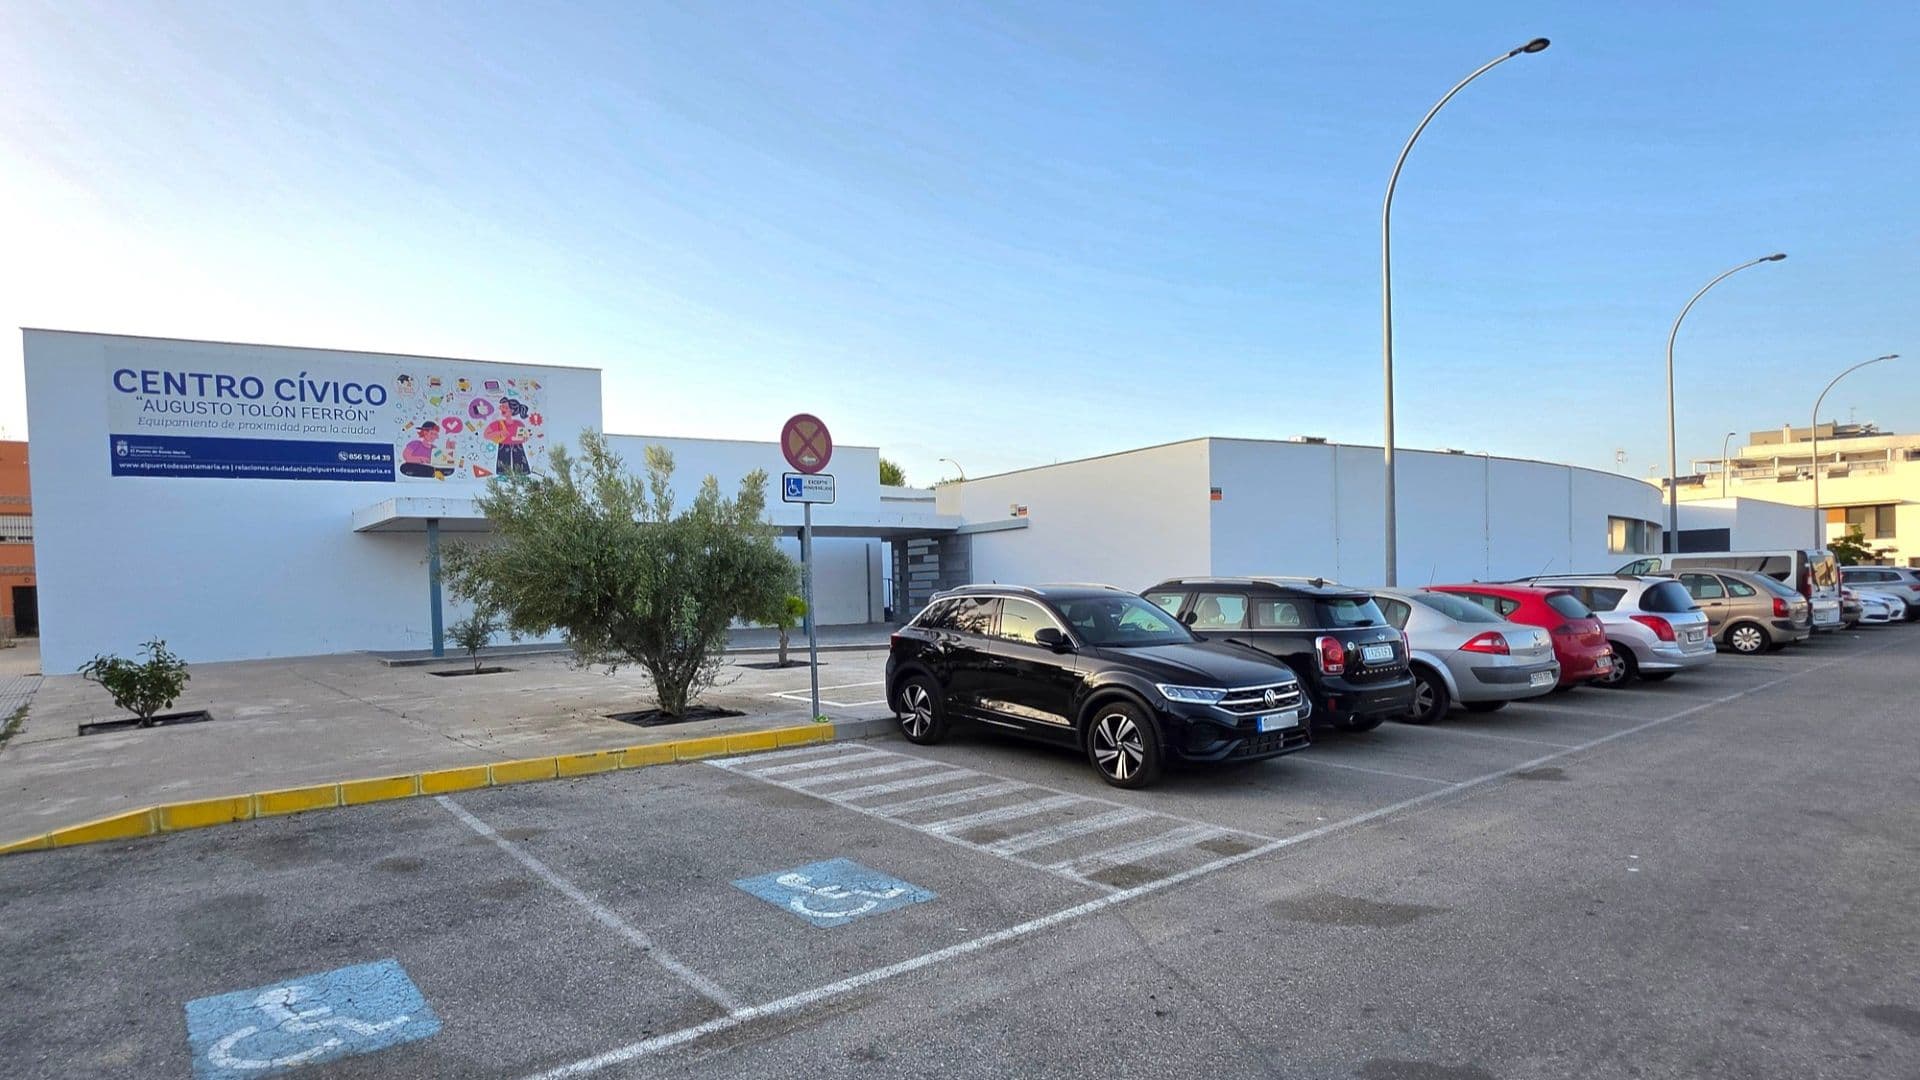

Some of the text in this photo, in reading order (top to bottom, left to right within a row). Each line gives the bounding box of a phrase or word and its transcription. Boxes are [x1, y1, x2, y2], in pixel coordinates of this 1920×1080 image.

[113, 369, 387, 406] CENTRO CÍVICO
[237, 401, 296, 418] TOLÓN
[138, 416, 376, 435] Equipamiento de proximidad para la ciudad
